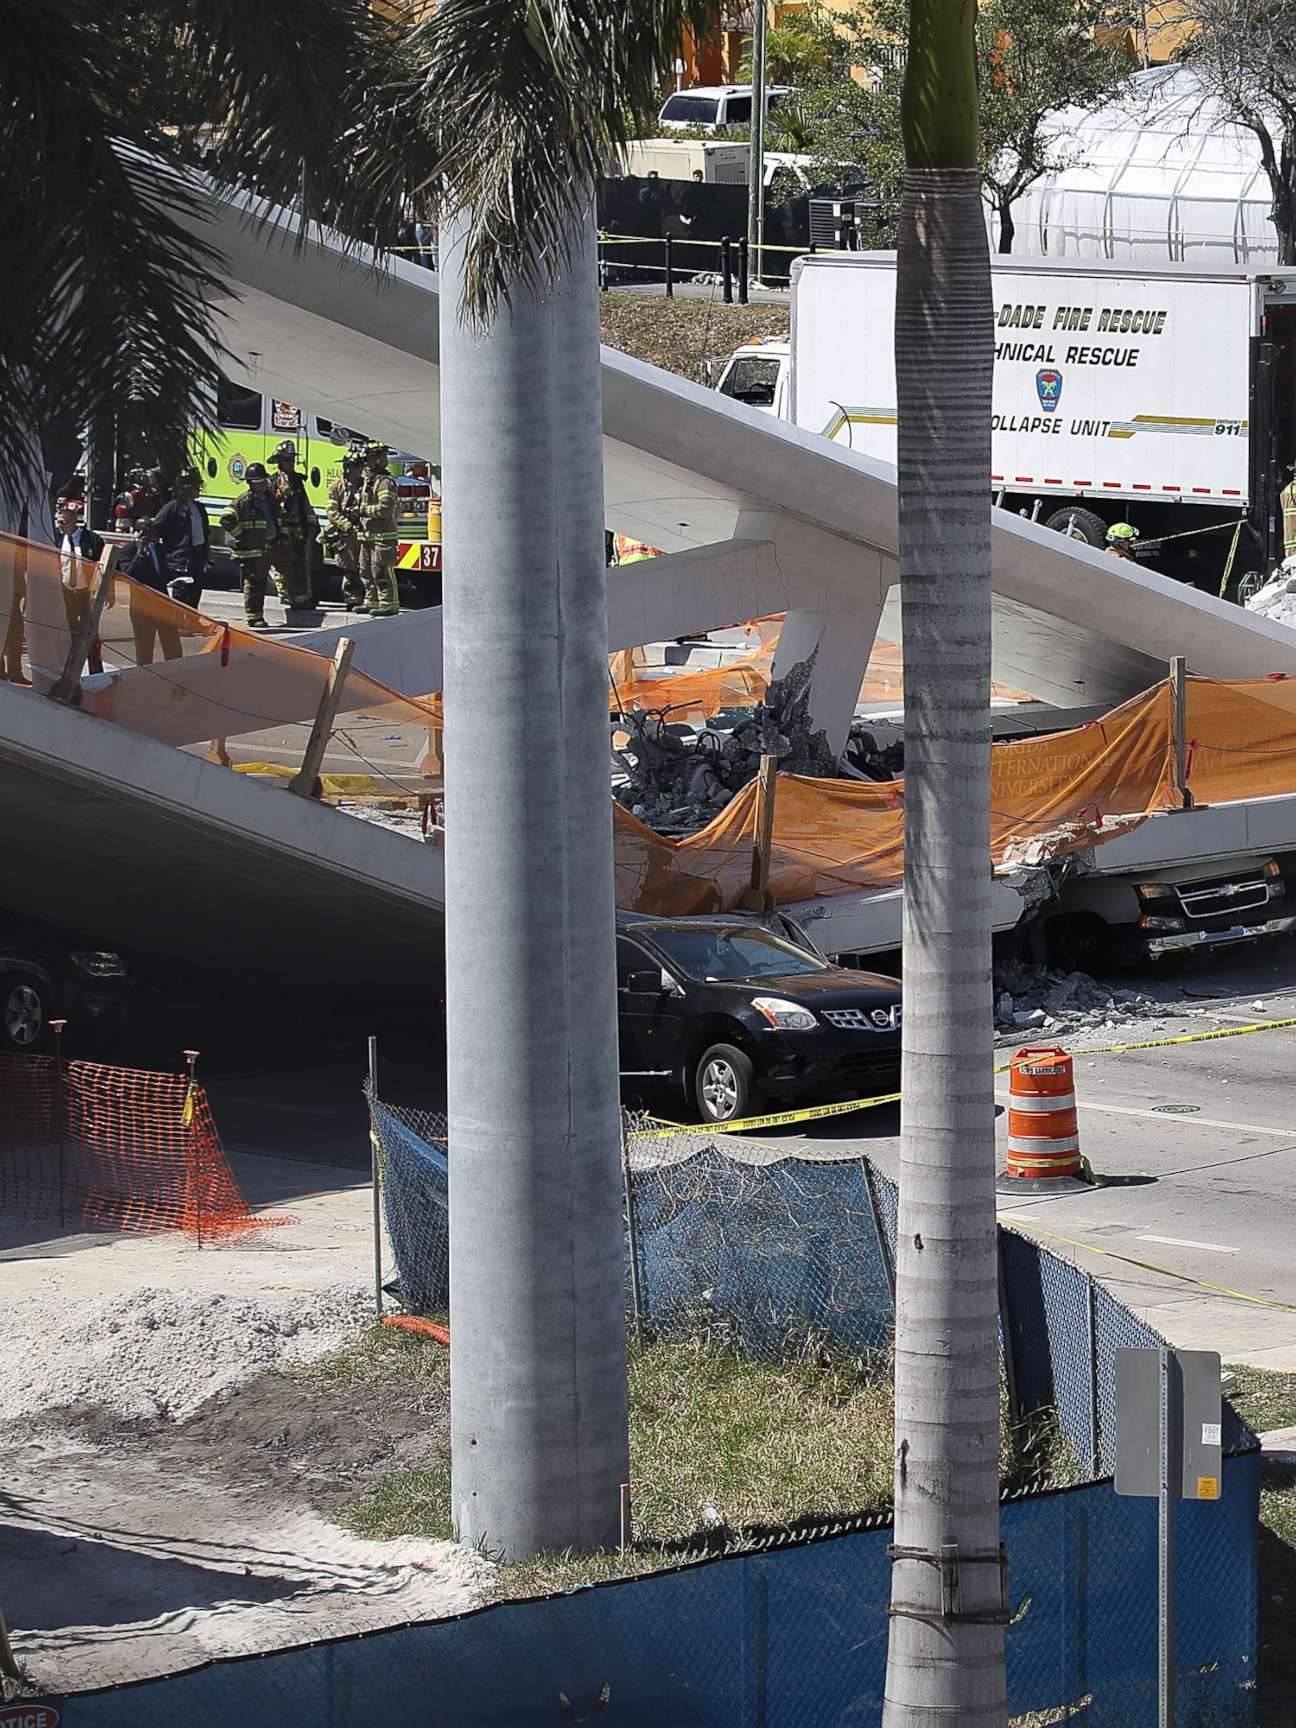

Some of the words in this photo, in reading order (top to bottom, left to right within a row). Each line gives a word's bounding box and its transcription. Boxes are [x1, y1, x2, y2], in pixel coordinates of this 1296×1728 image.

[1052, 306, 1094, 332] FIRE
[1097, 308, 1167, 335] RESCUE
[1065, 346, 1140, 367] RESCUE
[1071, 419, 1111, 438] UNIT
[1215, 425, 1240, 435] 911
[423, 546, 439, 567] 37
